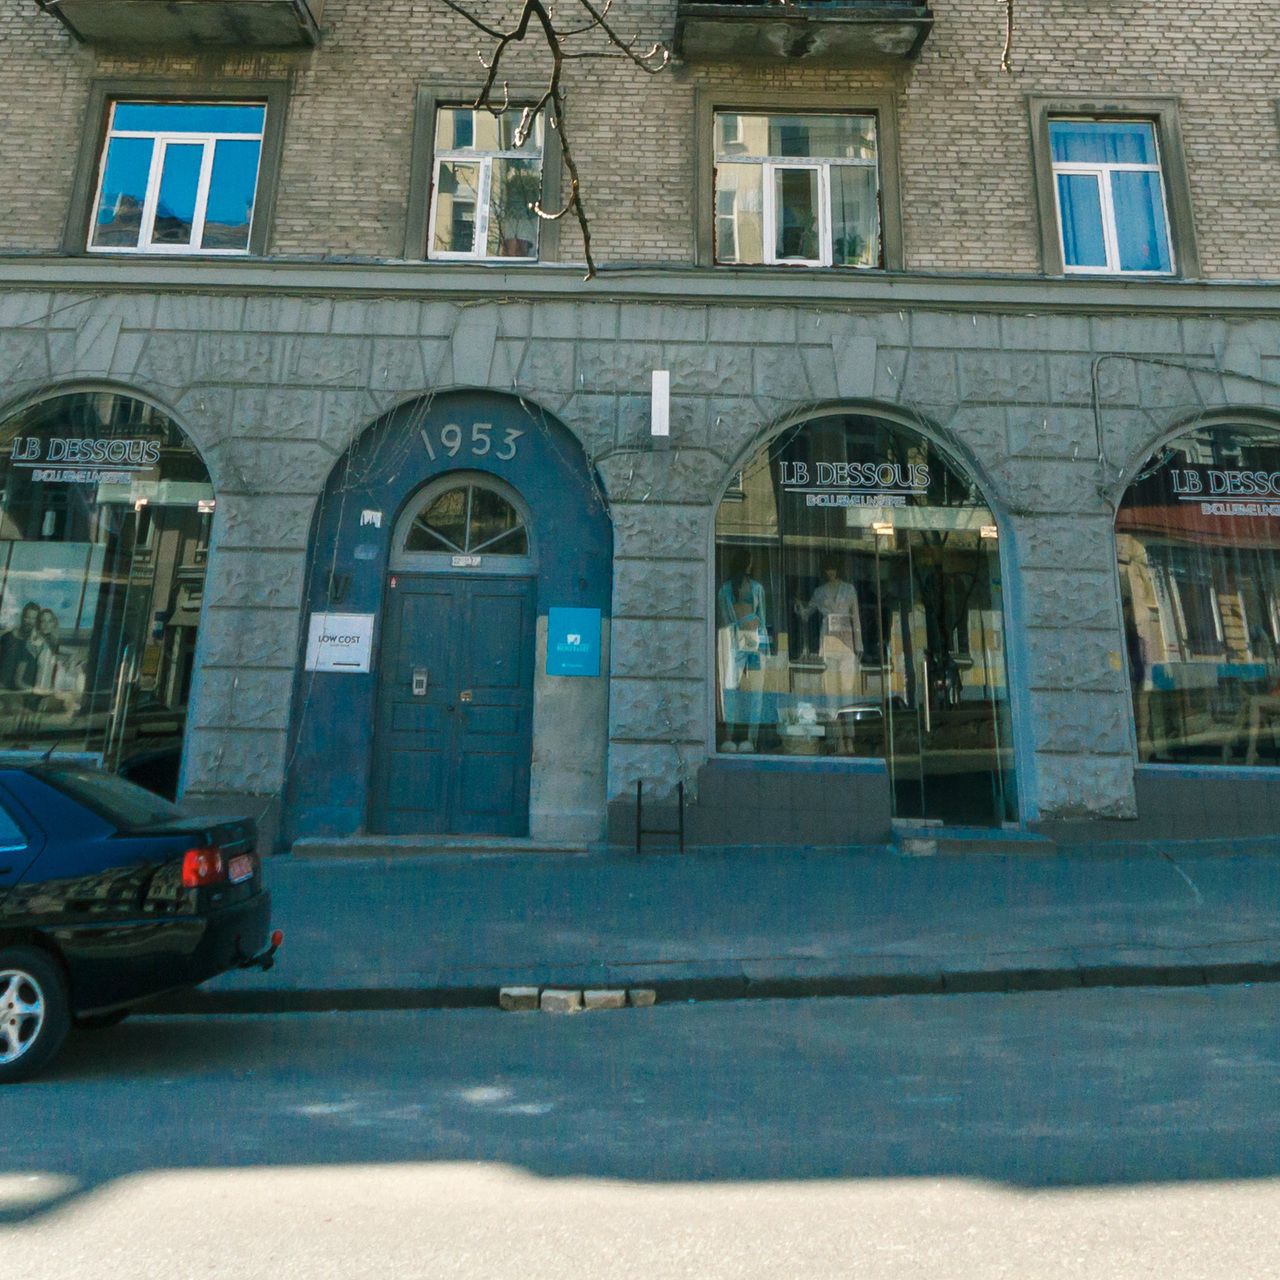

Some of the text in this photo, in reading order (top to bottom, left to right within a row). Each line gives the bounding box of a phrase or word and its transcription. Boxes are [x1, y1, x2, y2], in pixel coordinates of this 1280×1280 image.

[10, 437, 161, 464] LB DESSOUS
[420, 423, 524, 461] 1953
[780, 461, 931, 487] LB DESSOUS
[1171, 470, 1203, 493] LB
[318, 635, 361, 644] LOW COST
